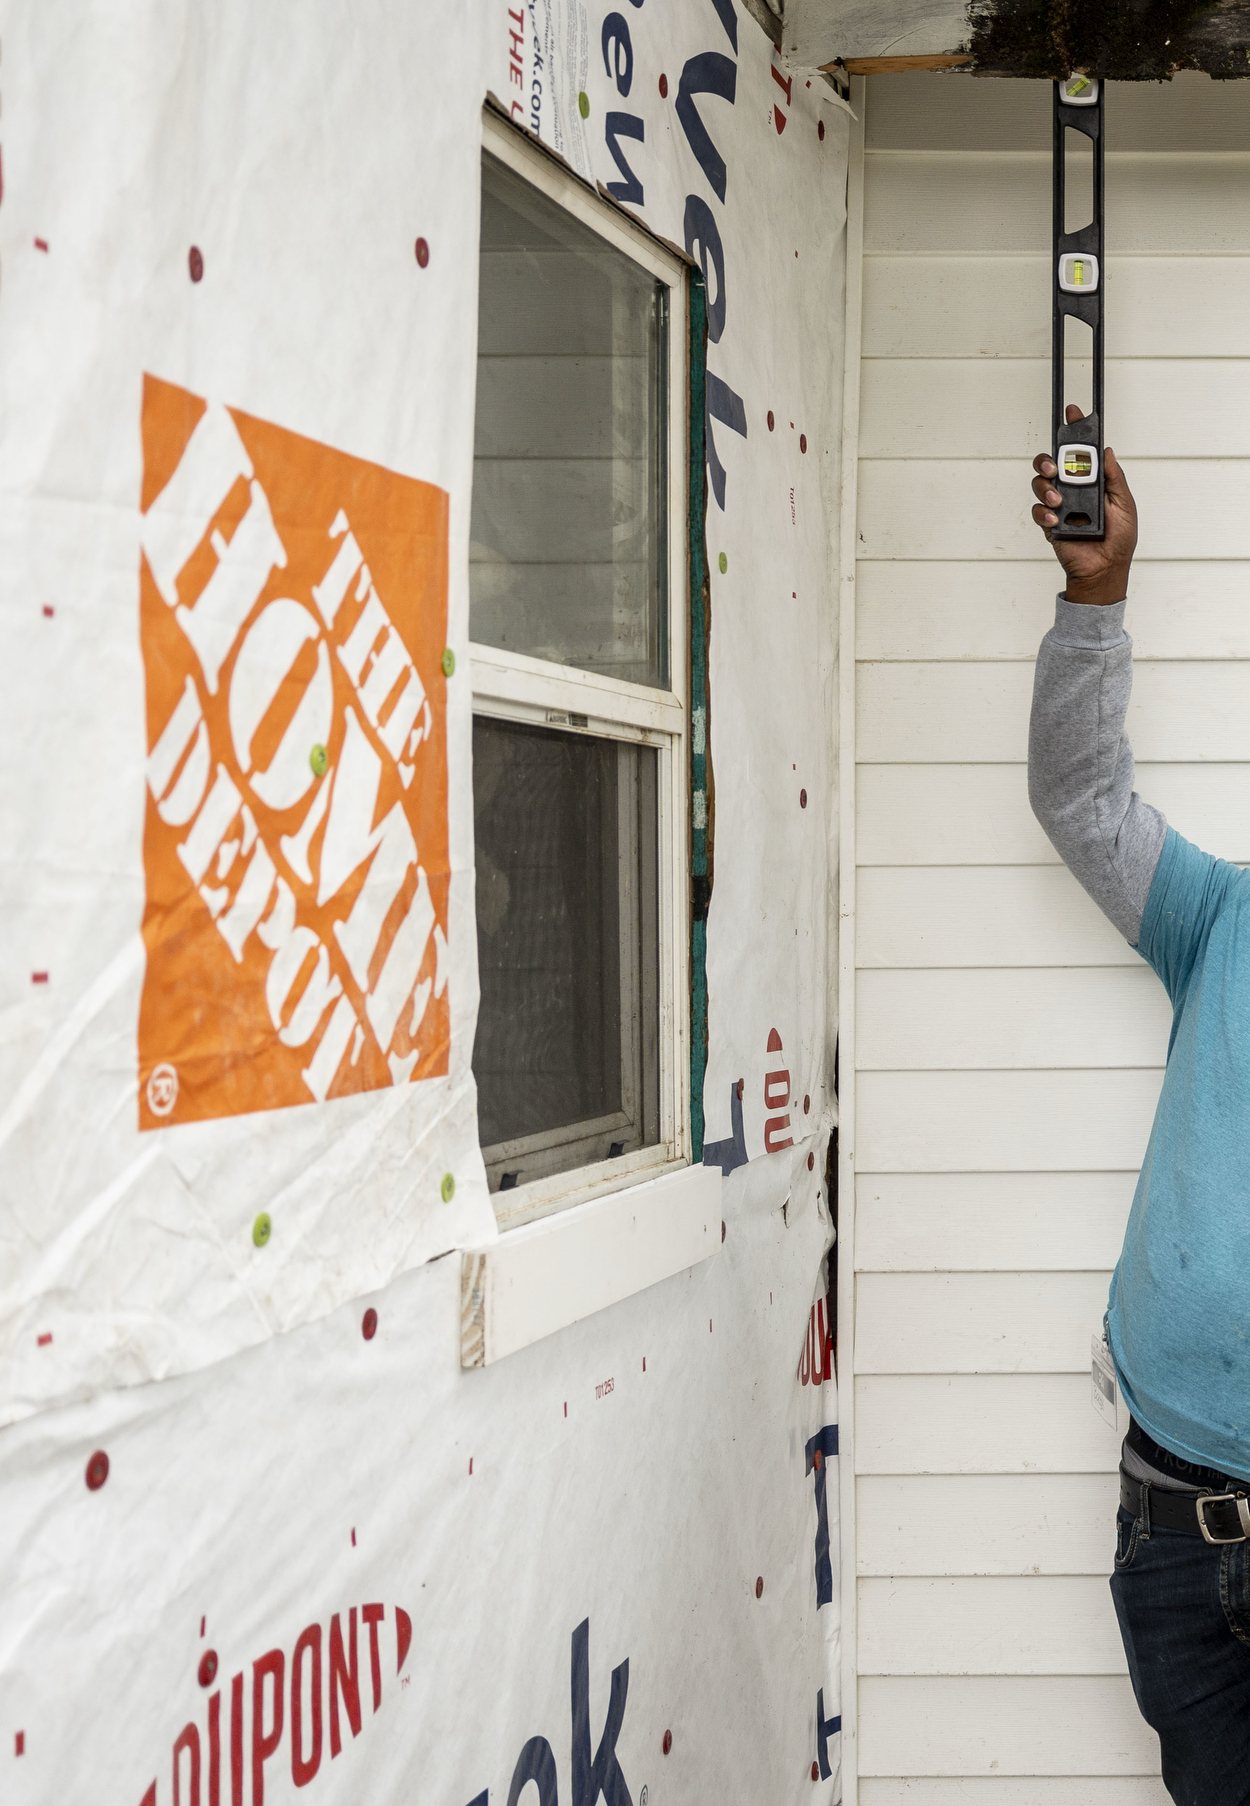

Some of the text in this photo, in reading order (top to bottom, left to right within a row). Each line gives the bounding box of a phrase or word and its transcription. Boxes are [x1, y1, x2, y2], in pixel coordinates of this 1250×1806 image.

[508, 8, 525, 91] THE
[141, 400, 449, 1086] HOME
[312, 507, 432, 790] THE
[145, 673, 365, 1103] DEPOT
